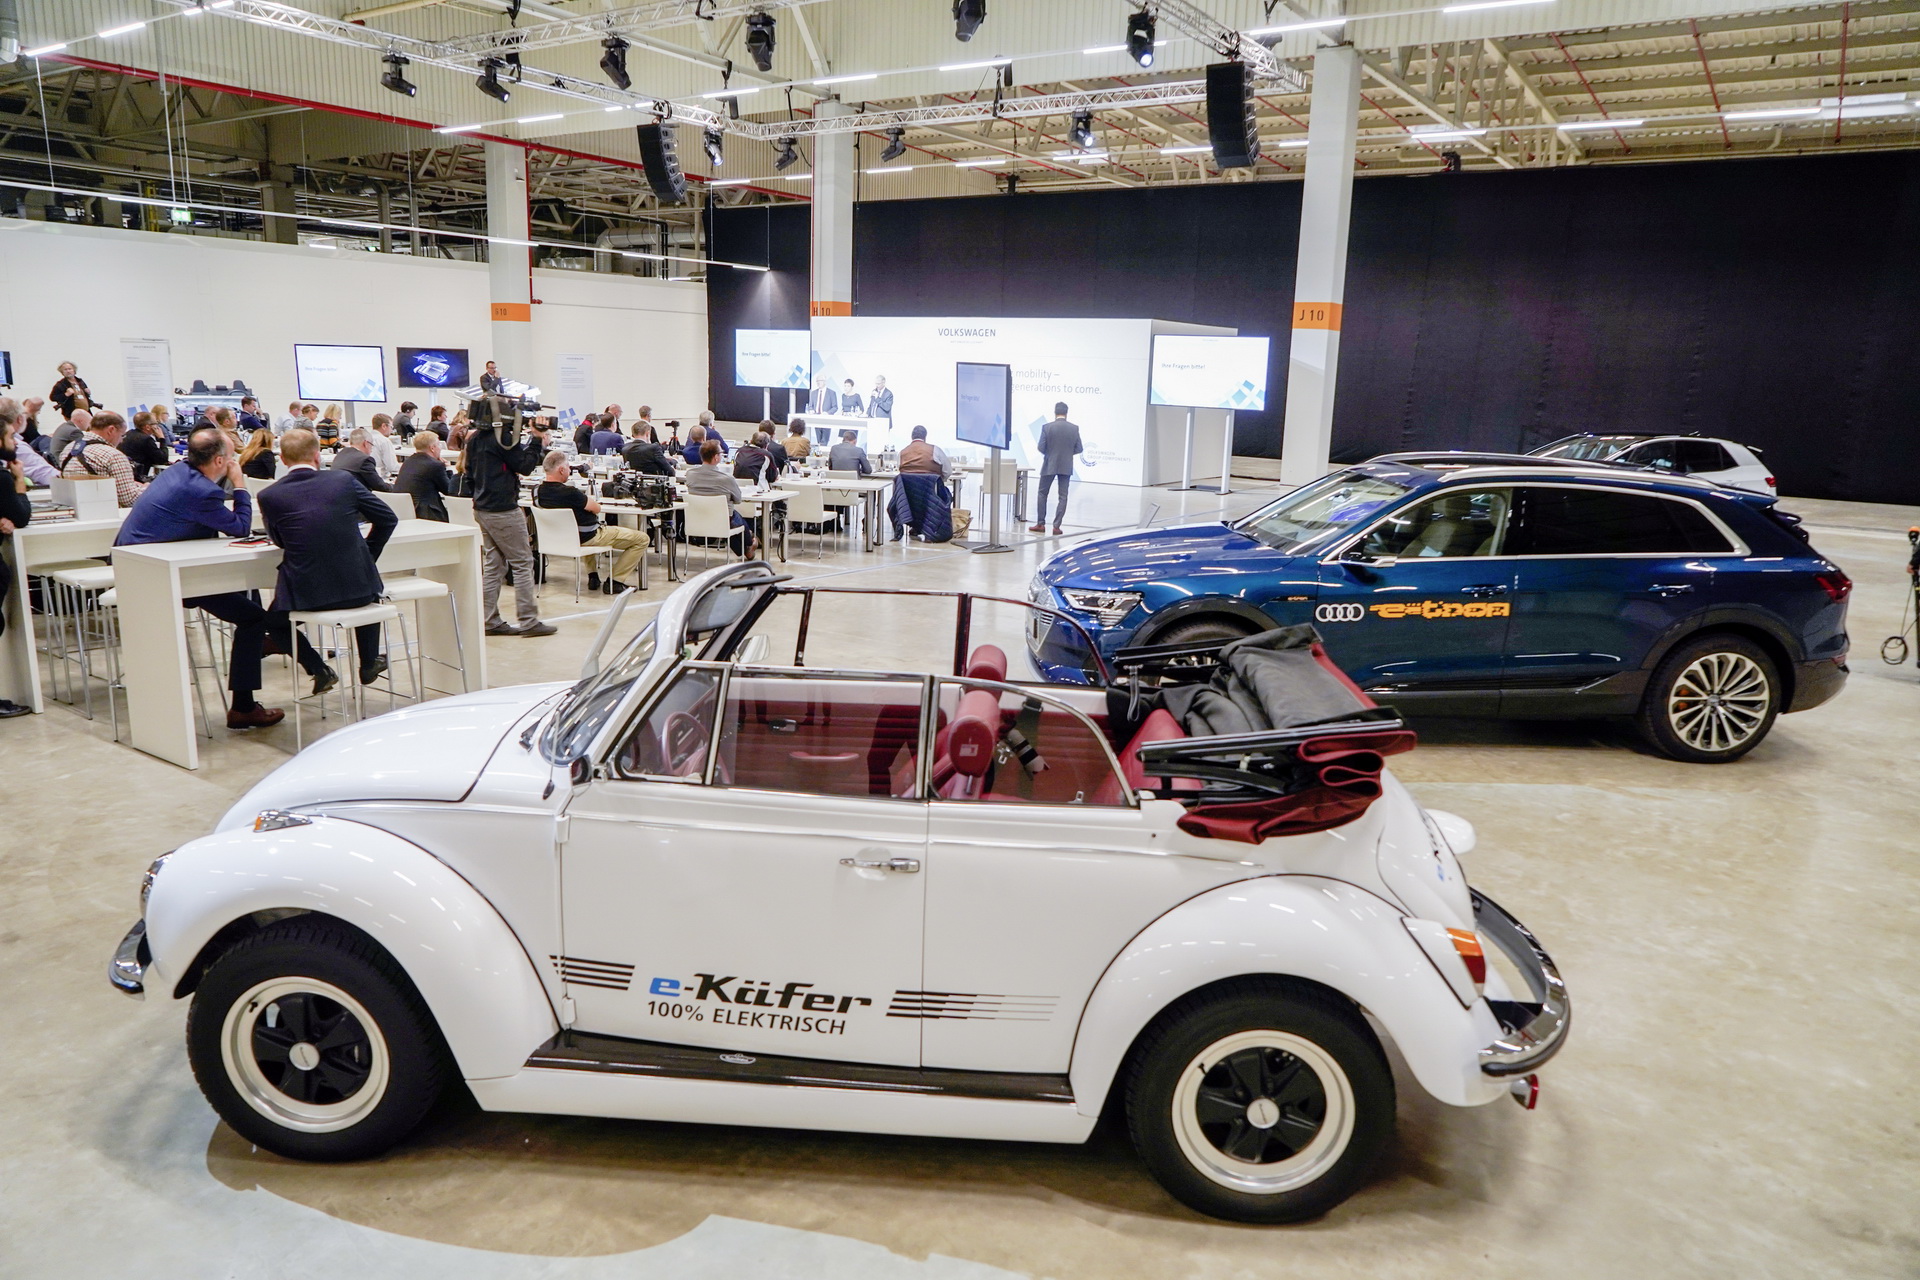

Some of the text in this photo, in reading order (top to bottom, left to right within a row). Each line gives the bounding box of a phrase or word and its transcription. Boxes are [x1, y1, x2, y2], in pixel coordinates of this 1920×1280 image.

[822, 307, 831, 316] 10
[1299, 309, 1324, 321] J 10
[938, 328, 996, 337] VOLKSWAGEN
[1016, 369, 1052, 381] mobility
[1064, 384, 1073, 393] to
[1075, 386, 1102, 394] come.
[649, 973, 872, 1014] e-Käfer
[648, 1000, 846, 1035] 100% ELEKTRISCH
